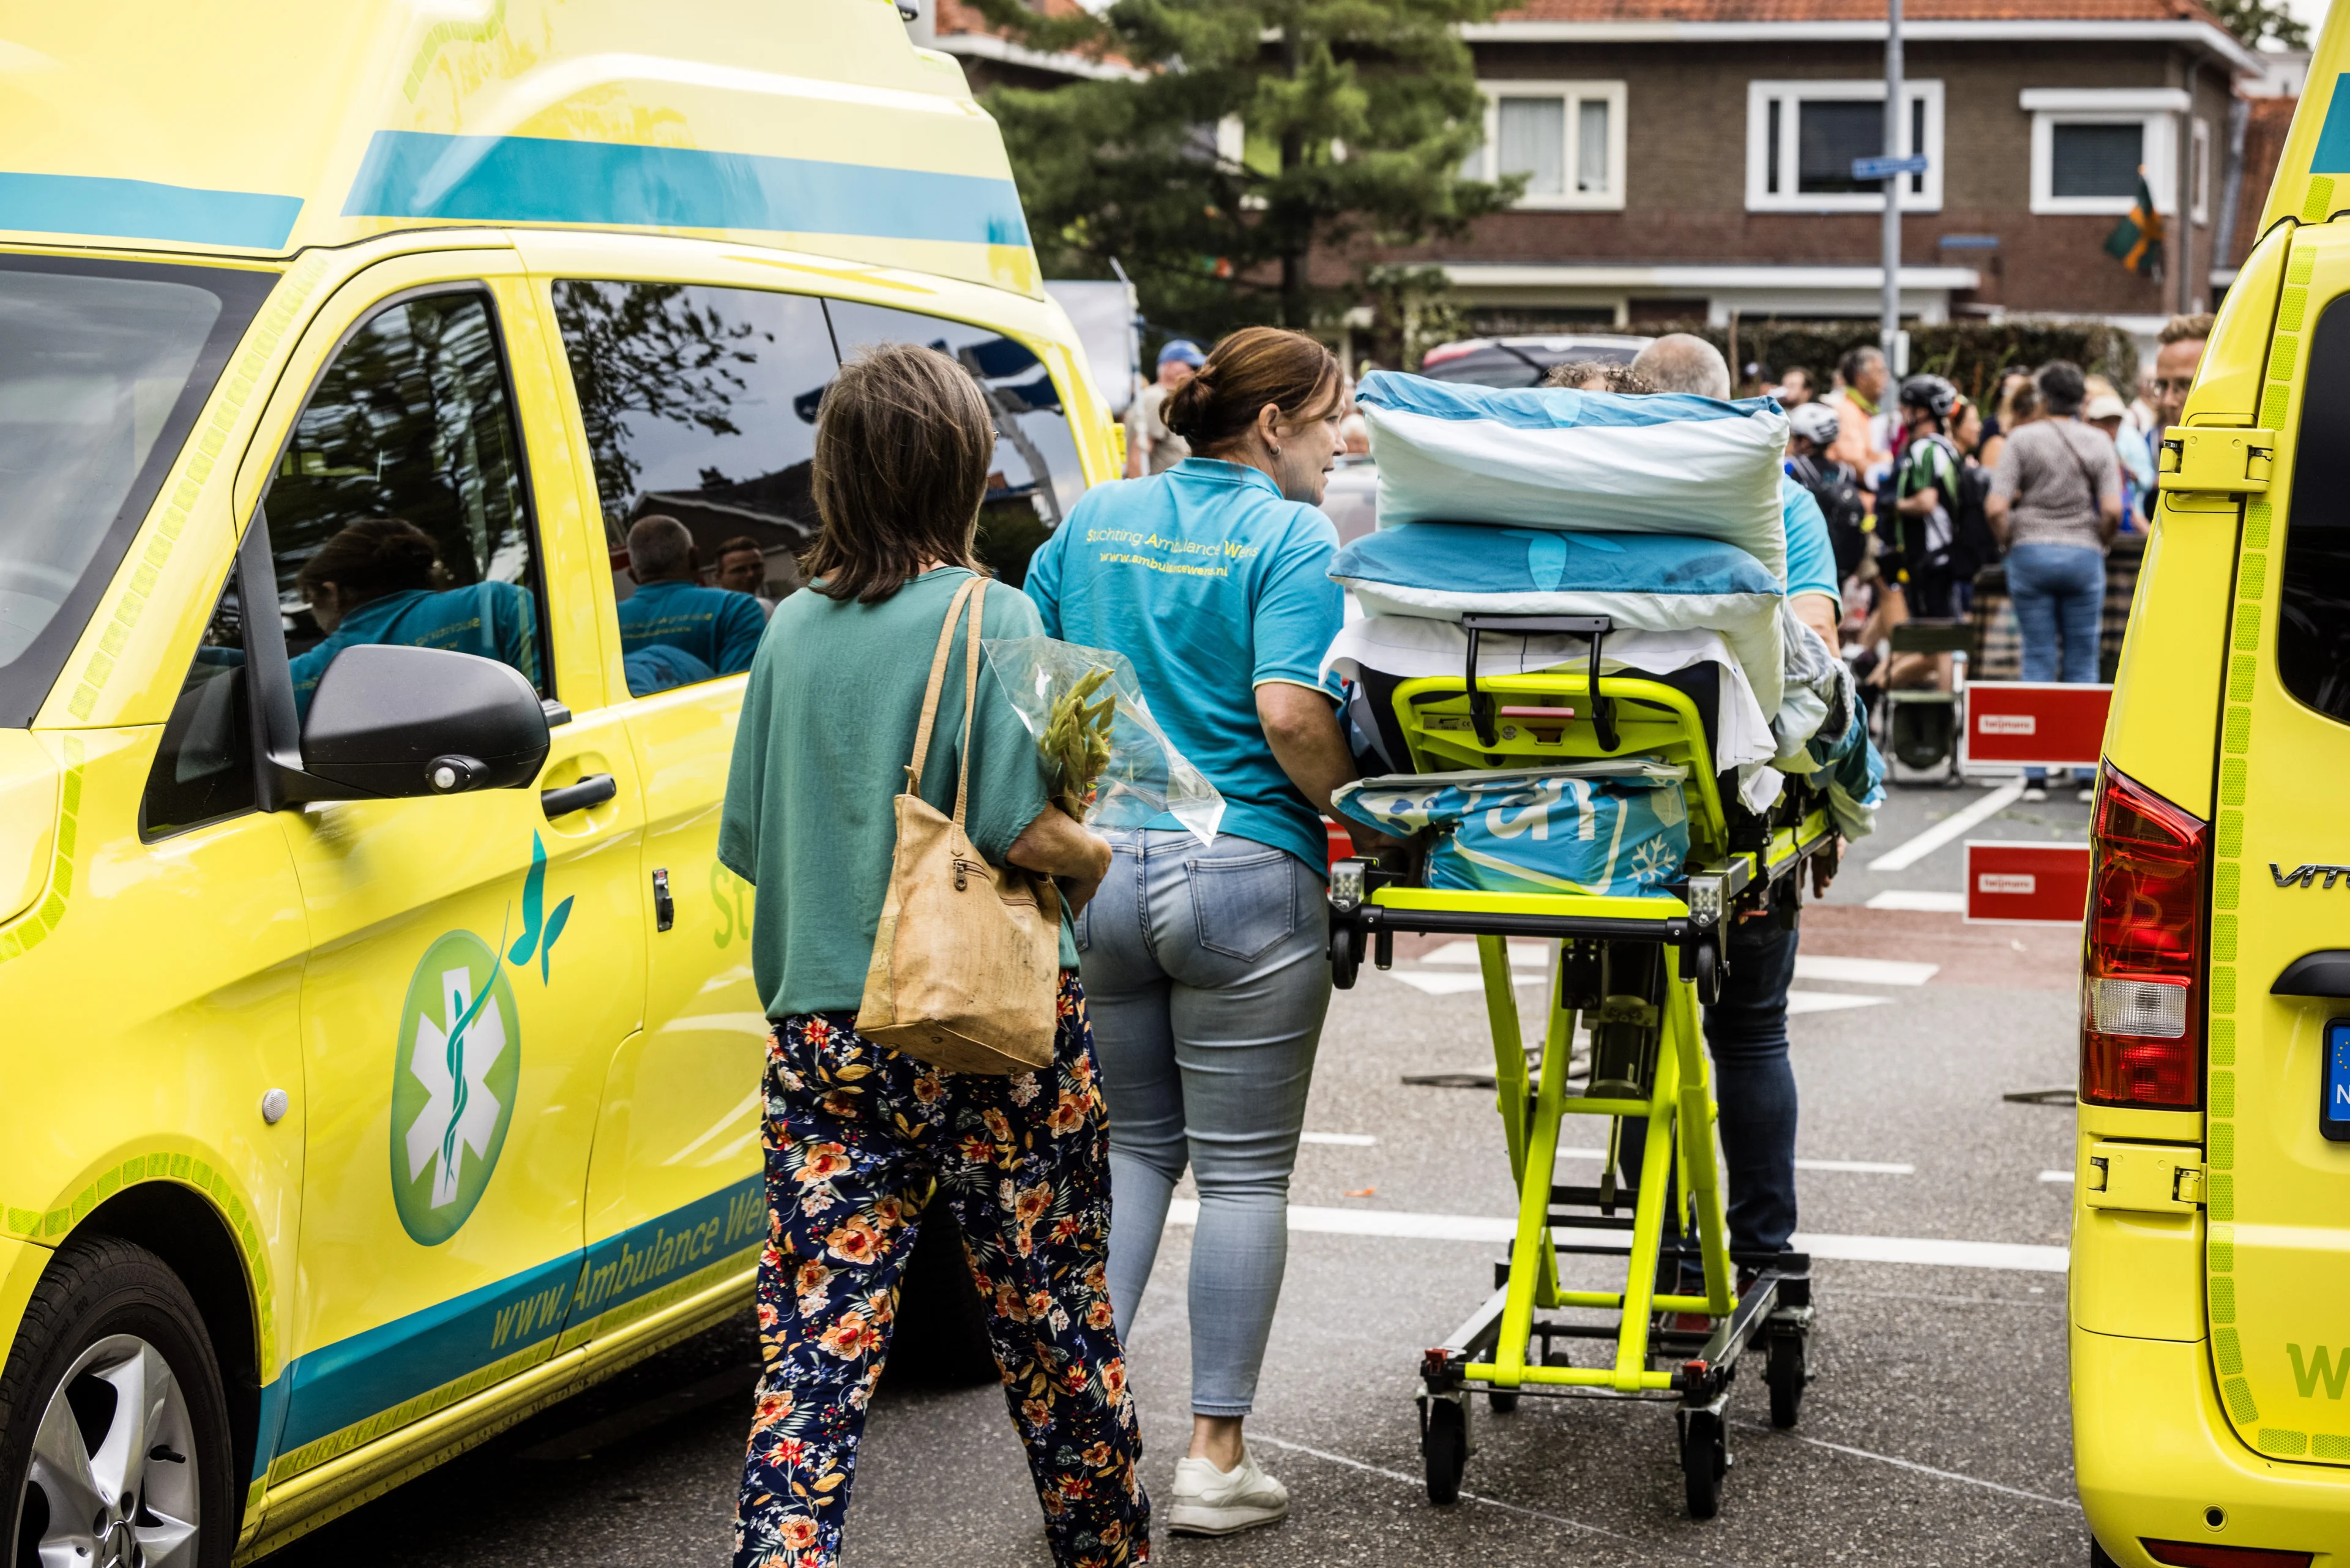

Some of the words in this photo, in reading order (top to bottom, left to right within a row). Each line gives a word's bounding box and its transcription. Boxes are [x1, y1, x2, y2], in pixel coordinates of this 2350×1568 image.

[1086, 527, 1143, 547] Stichting
[1225, 540, 1259, 558] Wens
[2268, 862, 2350, 889] VIT
[710, 859, 756, 949] St
[73, 1295, 89, 1317] 200
